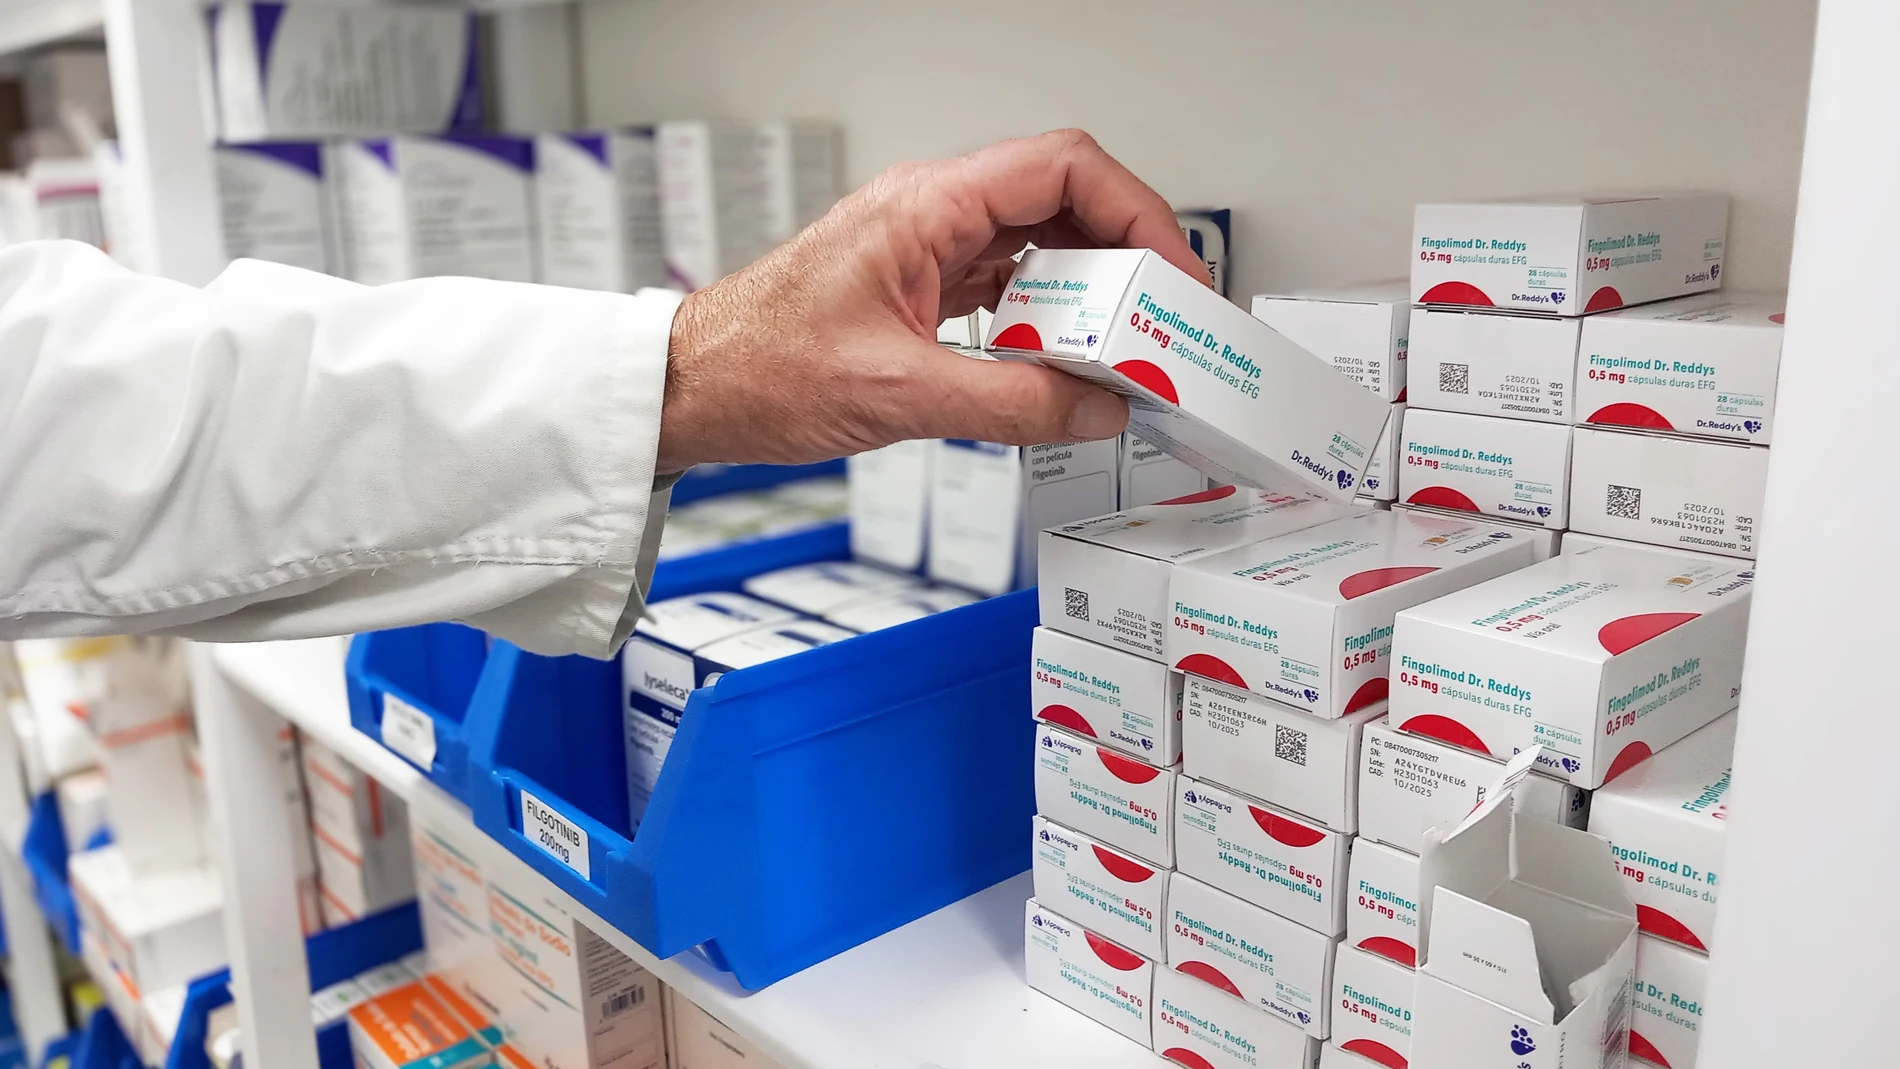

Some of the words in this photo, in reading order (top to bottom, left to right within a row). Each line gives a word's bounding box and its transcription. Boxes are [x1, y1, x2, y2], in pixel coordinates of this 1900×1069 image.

[1421, 237, 1473, 249] Fingolimod
[1475, 238, 1488, 249] Dr.
[1490, 239, 1526, 252] Reddys
[1420, 251, 1435, 262] 0,5
[1437, 253, 1452, 263] mg
[1453, 253, 1486, 263] cápsulas
[1488, 254, 1509, 264] duras
[1511, 255, 1526, 265] EFG
[1012, 277, 1052, 291] Fingolimod
[1050, 279, 1060, 290] Dr.
[1061, 280, 1088, 293] Reddys
[1007, 292, 1018, 304] 0,5
[1018, 292, 1031, 305] mg
[1511, 293, 1549, 304] Dr.Reddy's
[1137, 292, 1204, 343] Fingolimod
[1203, 333, 1218, 354] Dr.
[1221, 344, 1261, 378] Reddys
[1130, 313, 1151, 333] 0,5
[1150, 327, 1171, 348] mg
[1170, 341, 1212, 371] cápsulas
[1213, 364, 1240, 388] duras
[1240, 379, 1259, 399] EFG
[1590, 354, 1651, 369] Fingolimod
[1653, 359, 1669, 371] Dr.
[1672, 361, 1715, 376] Reddys
[1499, 383, 1540, 394] H2301063
[1505, 375, 1539, 384] 10/2025
[1588, 369, 1606, 381] 0,5
[1608, 372, 1625, 384] mg
[1627, 374, 1666, 386] cápsulas
[1669, 377, 1694, 388] duras
[1697, 379, 1715, 390] EFG
[1717, 395, 1727, 403] 28
[1696, 419, 1741, 432] Dr.Reddy's
[1332, 434, 1341, 444] 28
[1408, 442, 1460, 457] Fingolimod
[1462, 449, 1475, 459] Dr.
[1477, 451, 1512, 465] Reddys
[1290, 449, 1333, 481] Dr.Reddy's
[1407, 455, 1422, 466] 0,5
[1424, 459, 1438, 470] mg
[1440, 461, 1473, 472] cápsulas
[1474, 466, 1496, 476] duras
[1498, 468, 1513, 478] EFG
[1498, 503, 1535, 516] Dr.Reddy's
[1677, 511, 1724, 525] H2301063
[1683, 502, 1724, 515] 10/2025
[1735, 515, 1752, 524] CAD:
[1739, 544, 1751, 552] PC:
[1175, 601, 1225, 624] Fingolimod
[1227, 615, 1240, 629] Dr.
[1242, 619, 1277, 639] Reddys
[1174, 616, 1188, 629] 0,5
[1190, 622, 1204, 635] mg
[1206, 627, 1238, 643] cápsulas
[1240, 636, 1262, 649] duras
[1263, 641, 1278, 654] EFG
[1344, 652, 1359, 670] 0,5
[1361, 648, 1376, 664] mg
[1036, 657, 1077, 679] Fingolimod
[1078, 671, 1090, 683] Dr.
[1091, 676, 1120, 693] Reddys
[1401, 655, 1464, 682] Fingolimod
[1468, 673, 1483, 688] Dr.
[1487, 678, 1531, 700] Reddys
[1036, 671, 1048, 682] 0,5
[1049, 676, 1061, 688] mg
[1108, 695, 1120, 707] EFG
[1265, 680, 1302, 698] Dr.Reddy's
[1400, 671, 1418, 686] 0,5
[1420, 679, 1438, 694] mg
[1441, 686, 1481, 704] cápsulas
[1483, 696, 1510, 712] duras
[1513, 703, 1531, 717] EFG
[1207, 710, 1244, 728] H2301063
[1208, 720, 1239, 736] 10/2025
[1533, 724, 1544, 734] 28
[1370, 736, 1381, 746] PC:
[1383, 741, 1439, 762] 08470007305217
[1368, 766, 1383, 777] CAD:
[1394, 778, 1432, 797] 10/2025
[1393, 767, 1438, 789] H2301063
[1070, 790, 1097, 809] Reddys
[1098, 802, 1110, 815] Dr.
[1129, 800, 1141, 813] mg
[526, 799, 580, 847] FILGOTINIB
[1111, 807, 1156, 834] Fingolimod
[1142, 808, 1157, 820] 0,5
[539, 828, 569, 863] 200mg
[1216, 837, 1230, 850] EFG
[1232, 843, 1252, 858] duras
[1218, 851, 1250, 873] Reddys
[1254, 852, 1287, 871] cápsulas
[1607, 840, 1678, 874] ngolimod
[1682, 864, 1701, 881] Dr.
[1252, 865, 1265, 879] Dr.
[1288, 864, 1304, 879] mg
[1305, 873, 1322, 887] 0,5
[1268, 871, 1321, 902] Fingolimod
[1623, 865, 1645, 883] mg
[1647, 875, 1699, 899] cápsulas
[1067, 885, 1094, 905] Reddys
[1095, 898, 1106, 911] Dr.
[1358, 895, 1375, 909] 0,5
[1377, 904, 1393, 919] mg
[1108, 904, 1151, 932] Fingolimod
[1175, 910, 1223, 940] Fingolimod
[1225, 933, 1237, 946] Dr.
[1240, 939, 1273, 962] Reddys
[1174, 923, 1188, 937] 0,5
[1190, 932, 1203, 946] mg
[1259, 963, 1273, 976] EFG
[1343, 984, 1401, 1017] Fingolimod
[1647, 984, 1666, 1002] Dr.
[1342, 999, 1358, 1013] 0,5
[1361, 1008, 1376, 1023] mg
[1665, 1011, 1696, 1031] duras
[1161, 998, 1208, 1029] Fingolimod
[1209, 1022, 1222, 1037] Dr.
[1224, 1030, 1255, 1053] Reddys
